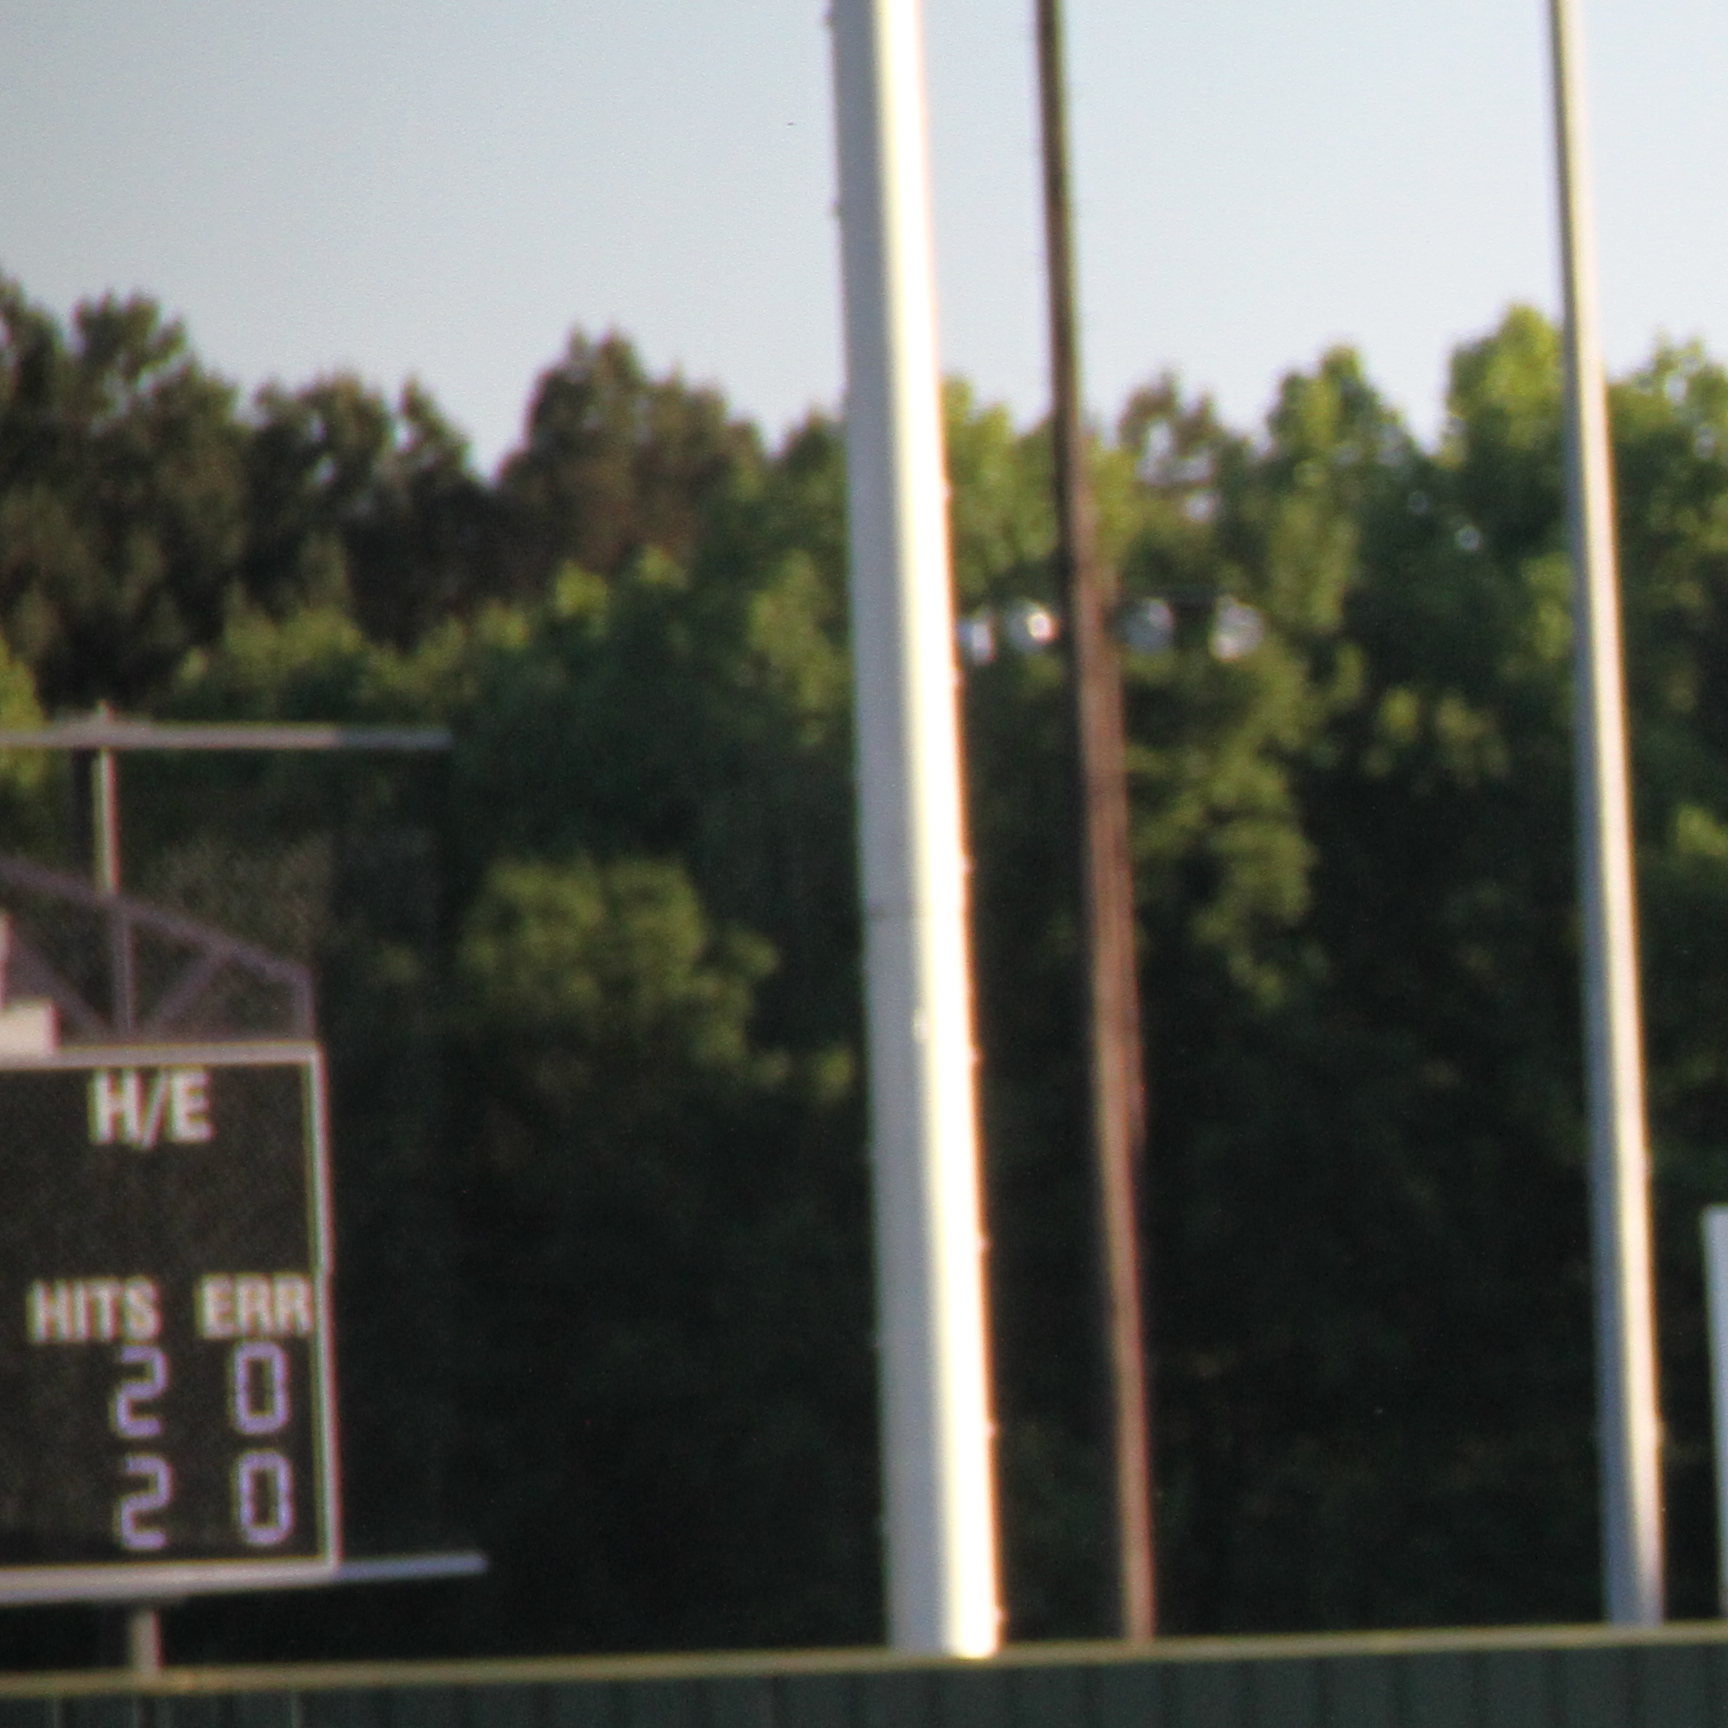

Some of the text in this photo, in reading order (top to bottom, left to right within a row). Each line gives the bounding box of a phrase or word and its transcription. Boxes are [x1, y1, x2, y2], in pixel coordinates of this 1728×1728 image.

[88, 1069, 214, 1147] H/E
[28, 1272, 314, 1342] HITS ERR
[114, 1340, 289, 1438] 2 0
[120, 1450, 293, 1551] 2 0
